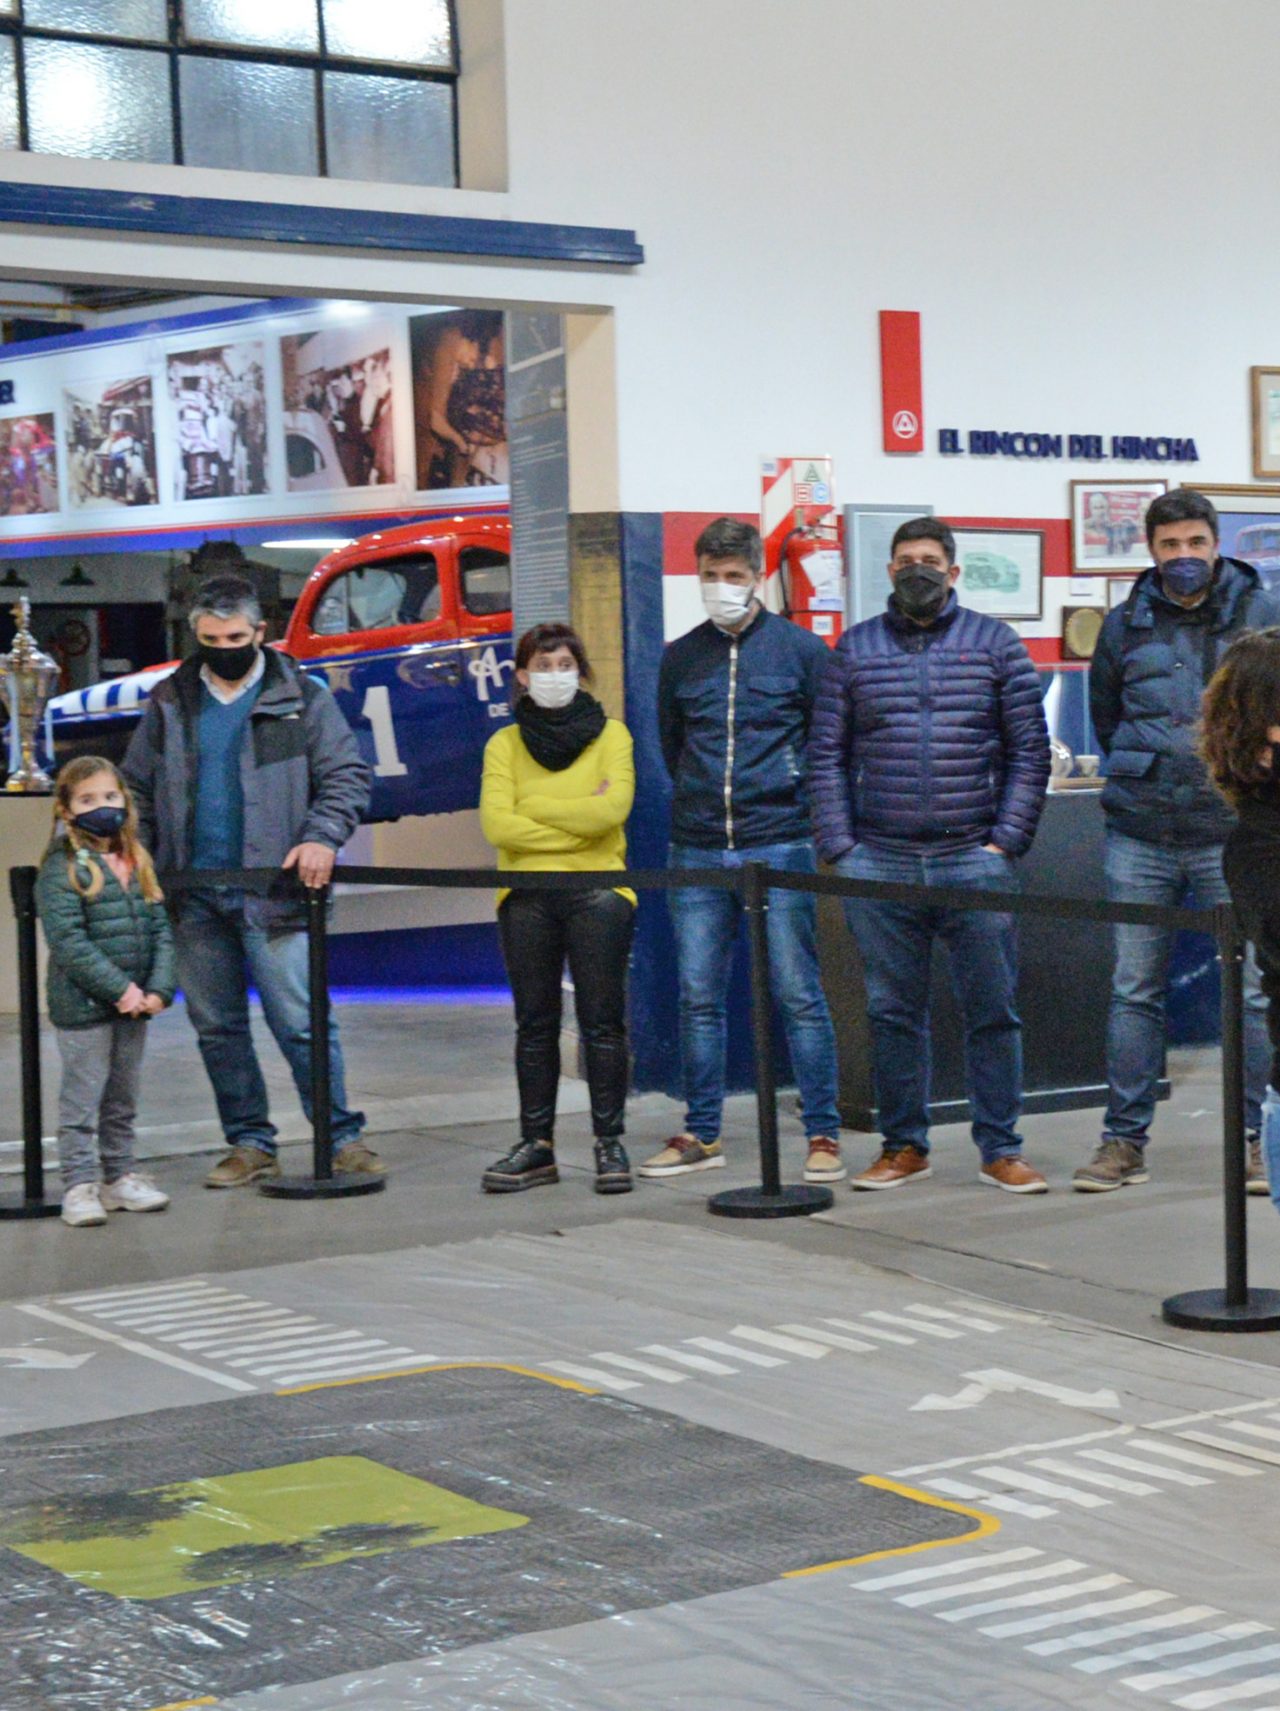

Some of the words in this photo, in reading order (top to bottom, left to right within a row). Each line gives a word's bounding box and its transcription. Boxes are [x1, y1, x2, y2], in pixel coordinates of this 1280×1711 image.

[938, 429, 963, 453] EL
[969, 430, 1062, 457] RINCON
[1068, 434, 1107, 458] DEL
[1111, 436, 1199, 461] HINCHA
[488, 703, 510, 718] DE
[361, 685, 408, 777] 1
